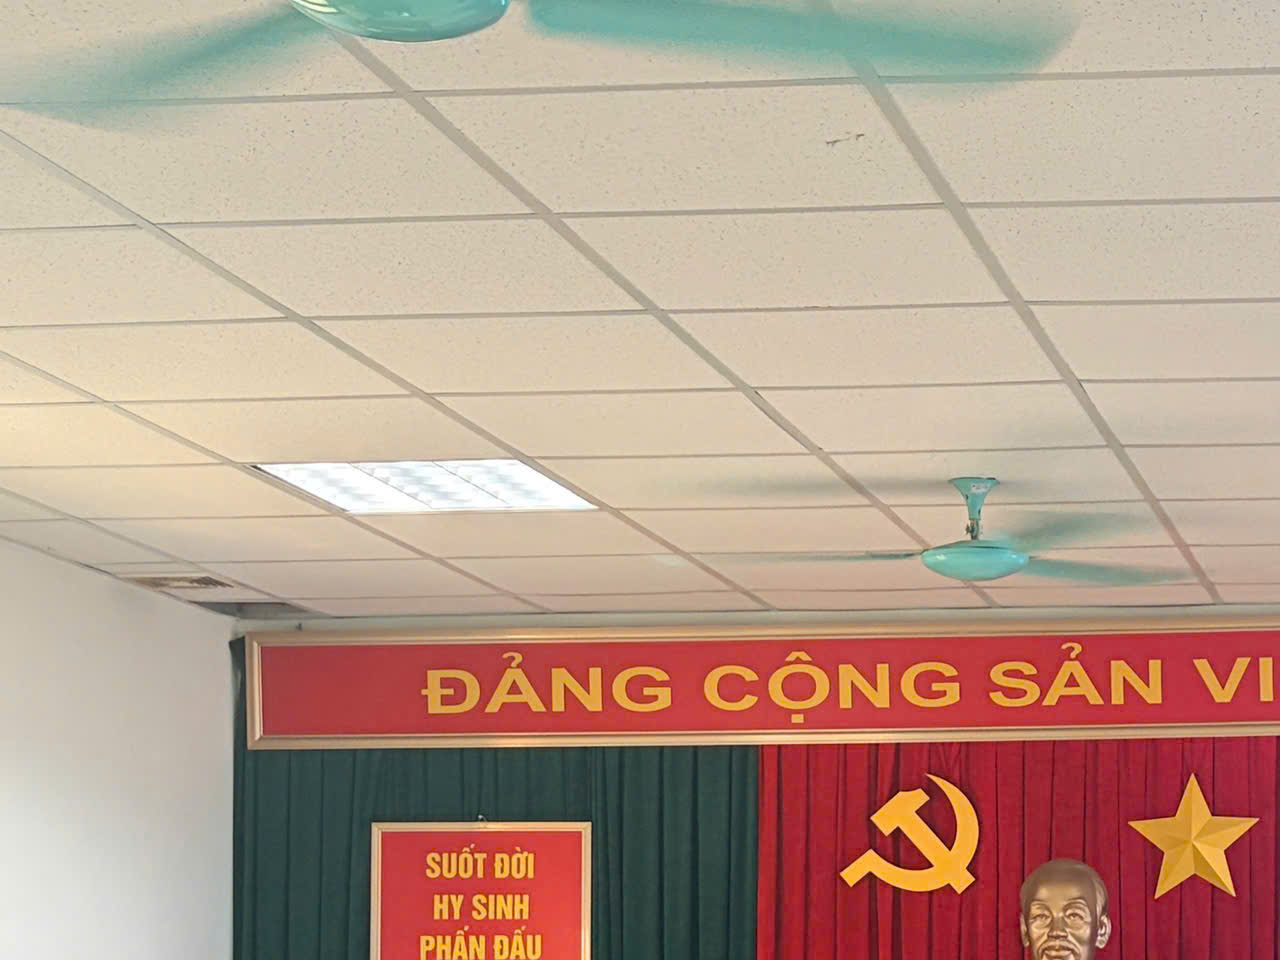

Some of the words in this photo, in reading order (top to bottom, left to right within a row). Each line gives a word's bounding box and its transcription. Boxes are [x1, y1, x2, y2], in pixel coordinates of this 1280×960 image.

[421, 651, 671, 715] ĐẢNG
[703, 651, 961, 724] CỘNG
[989, 642, 1162, 708] SẢN
[426, 843, 487, 879] SUỐT
[494, 847, 535, 879] ĐỜI
[434, 895, 464, 920] HY
[472, 894, 529, 920] SINH
[420, 926, 485, 960] PHẤN
[494, 926, 542, 960] ĐẤU
